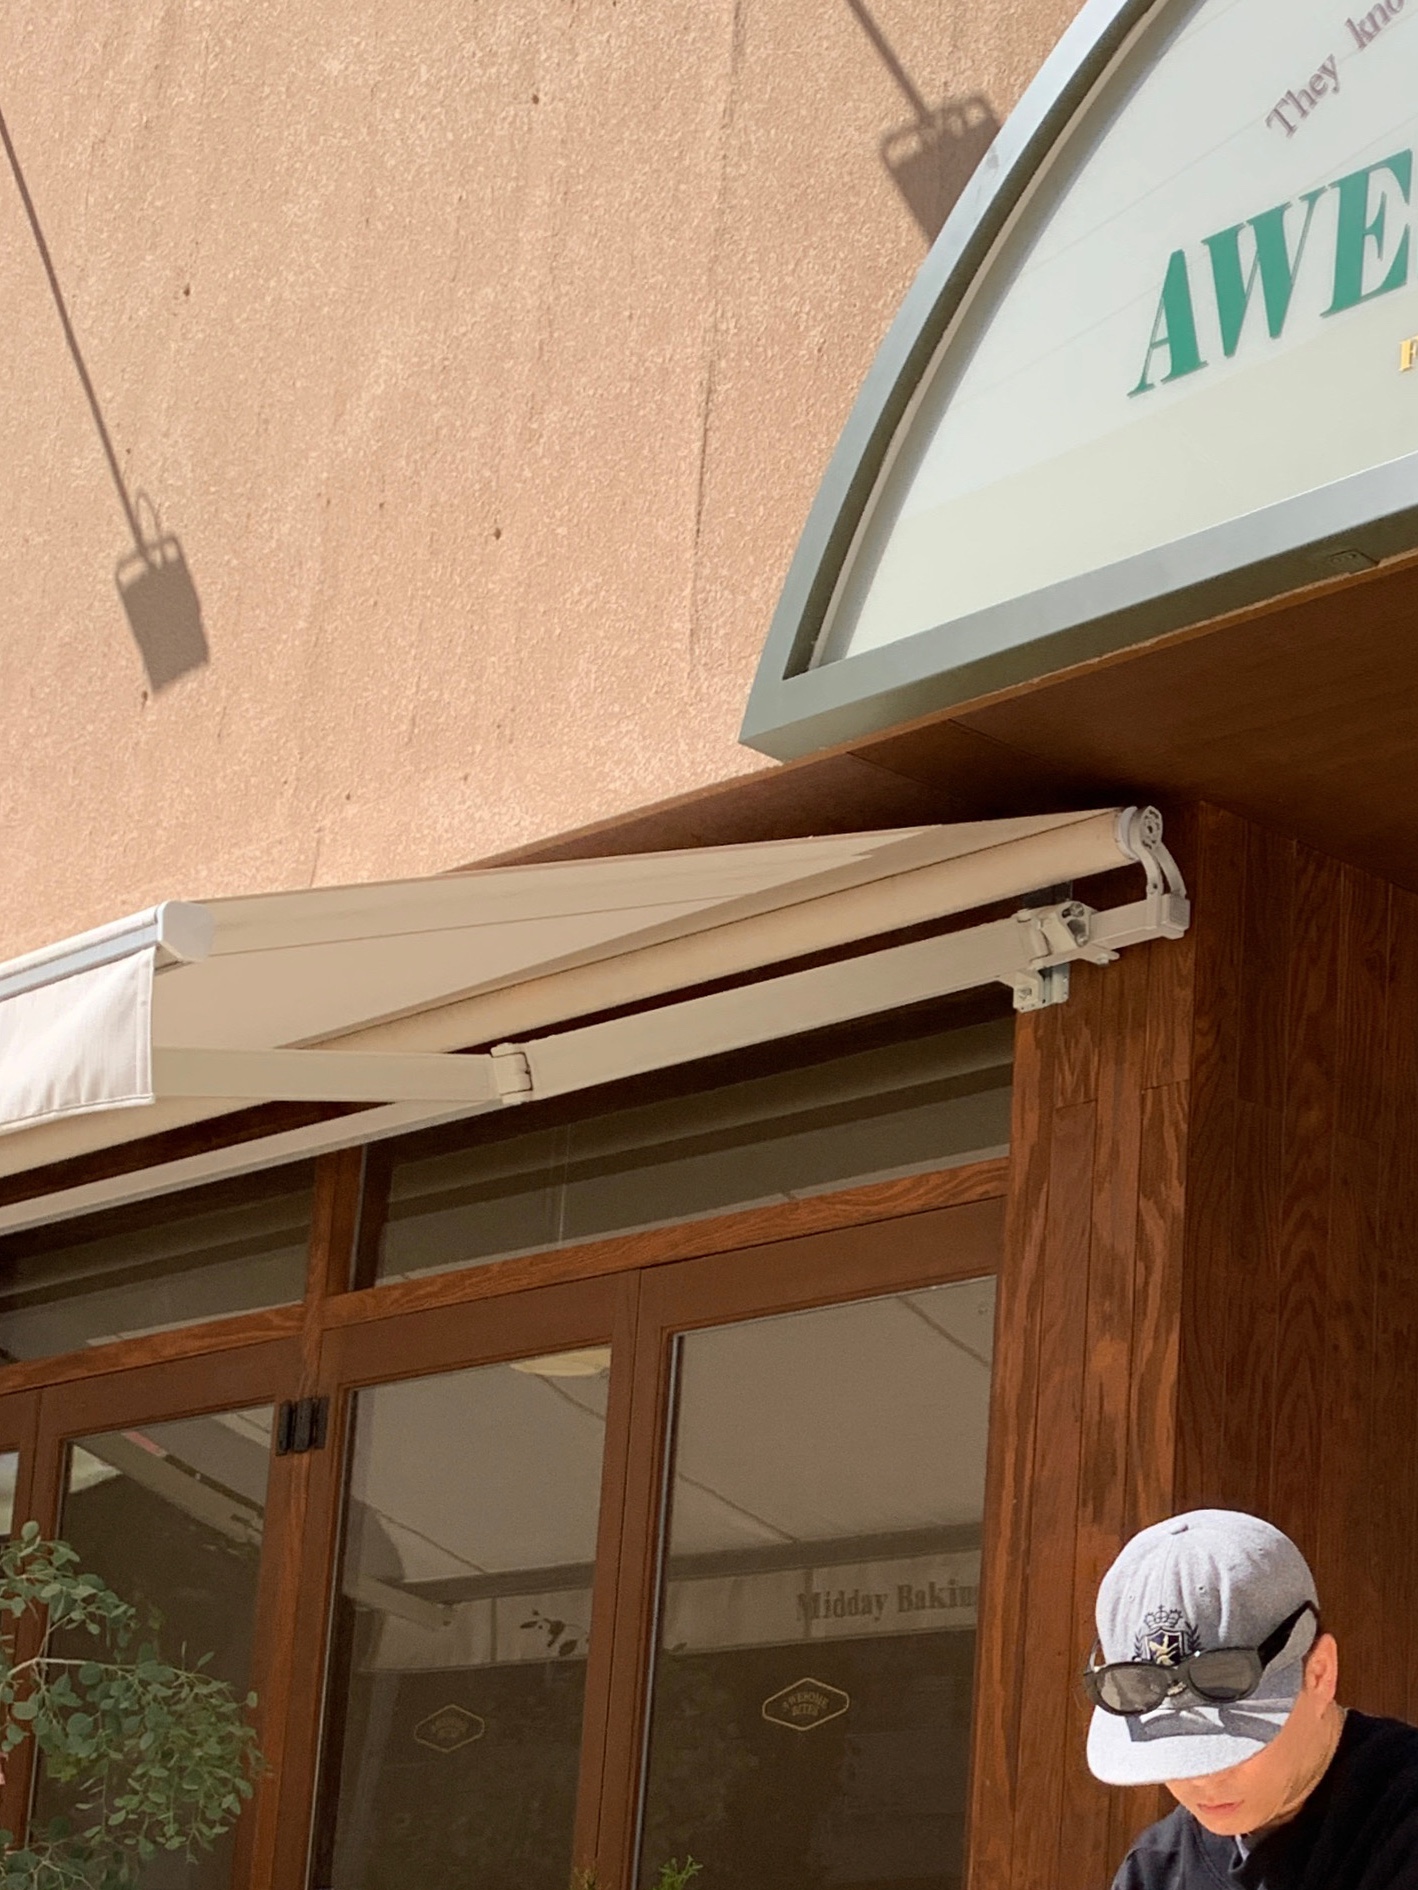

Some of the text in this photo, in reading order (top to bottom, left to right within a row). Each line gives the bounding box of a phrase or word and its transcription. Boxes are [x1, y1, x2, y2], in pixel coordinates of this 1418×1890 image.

[1265, 54, 1340, 138] They
[797, 1578, 978, 1622] Midday Bakin
